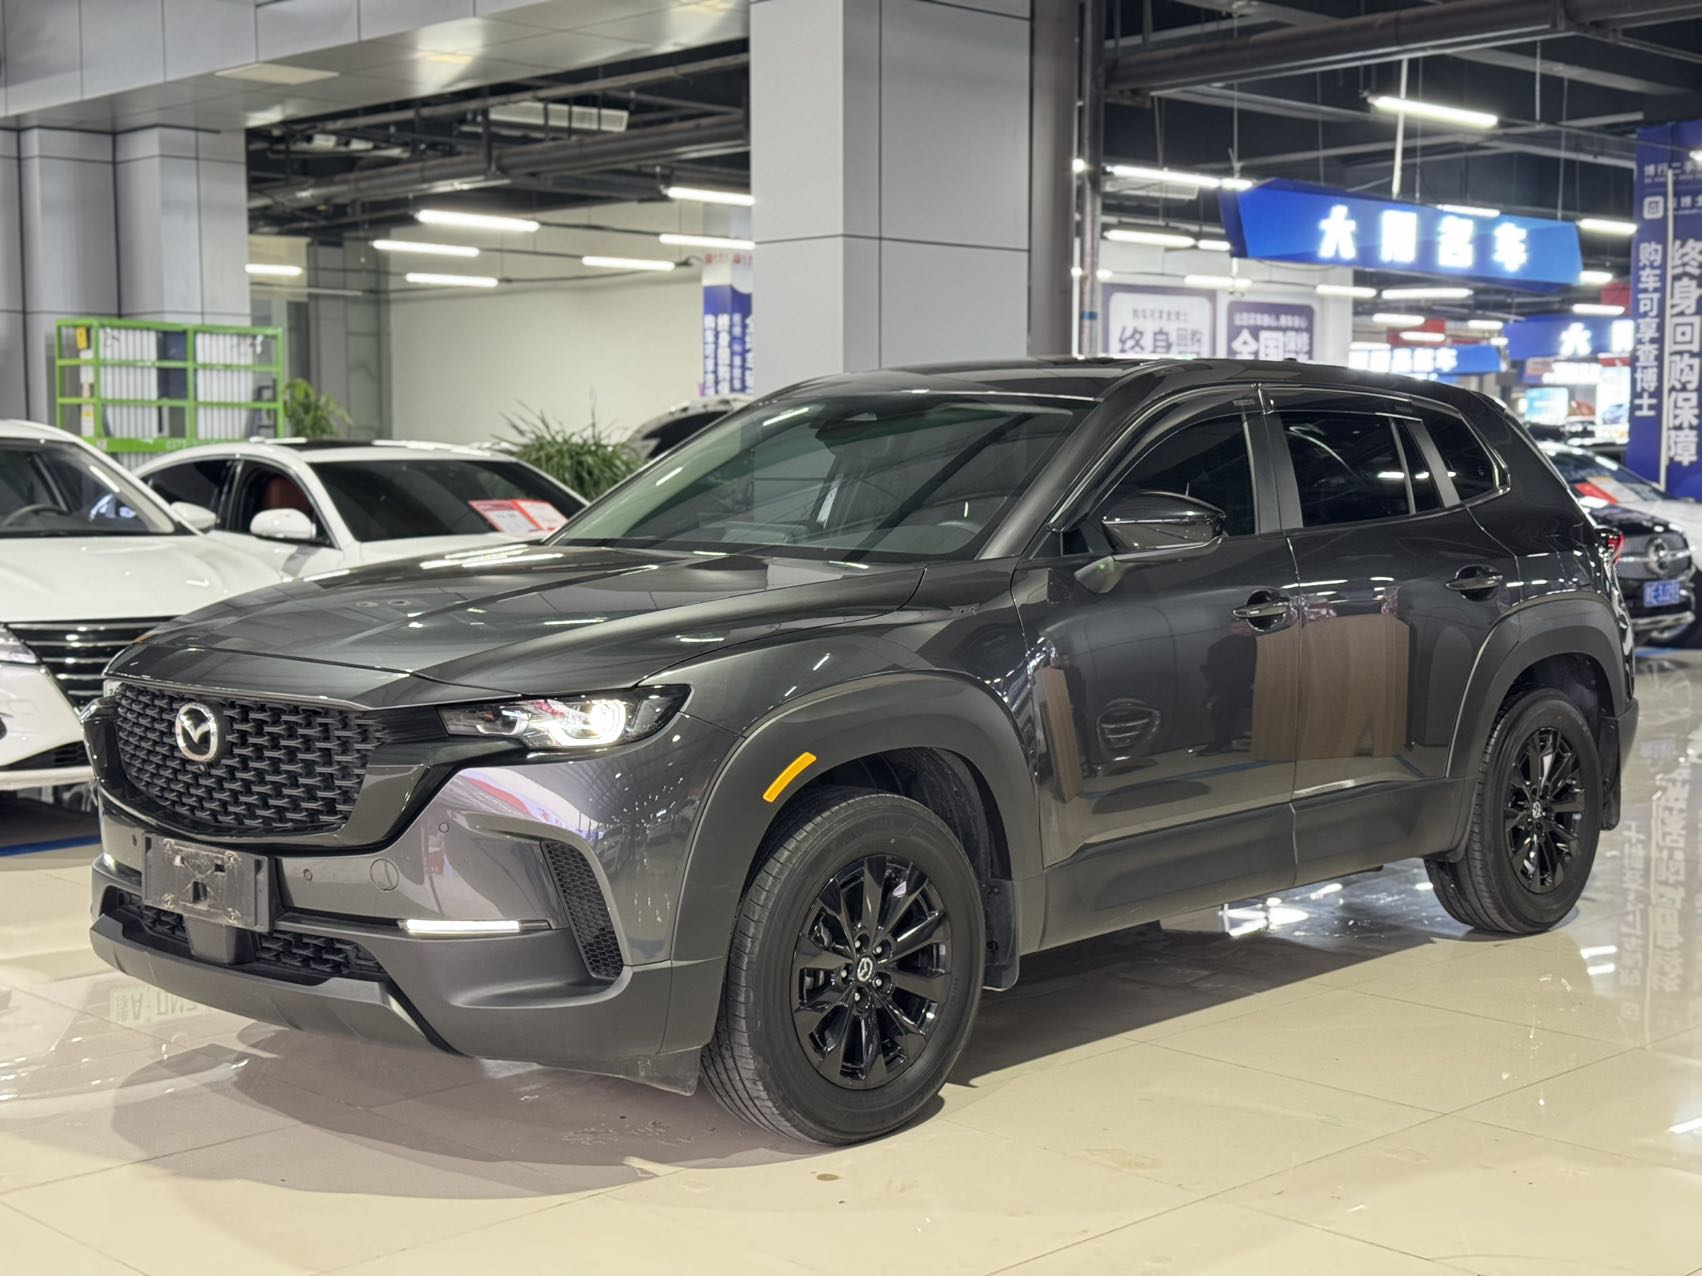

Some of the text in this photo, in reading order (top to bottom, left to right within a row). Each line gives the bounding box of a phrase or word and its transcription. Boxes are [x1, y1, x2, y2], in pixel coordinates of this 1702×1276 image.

[1634, 241, 1663, 416] 购车可享查博士
[1666, 239, 1702, 466] 终身回购保障
